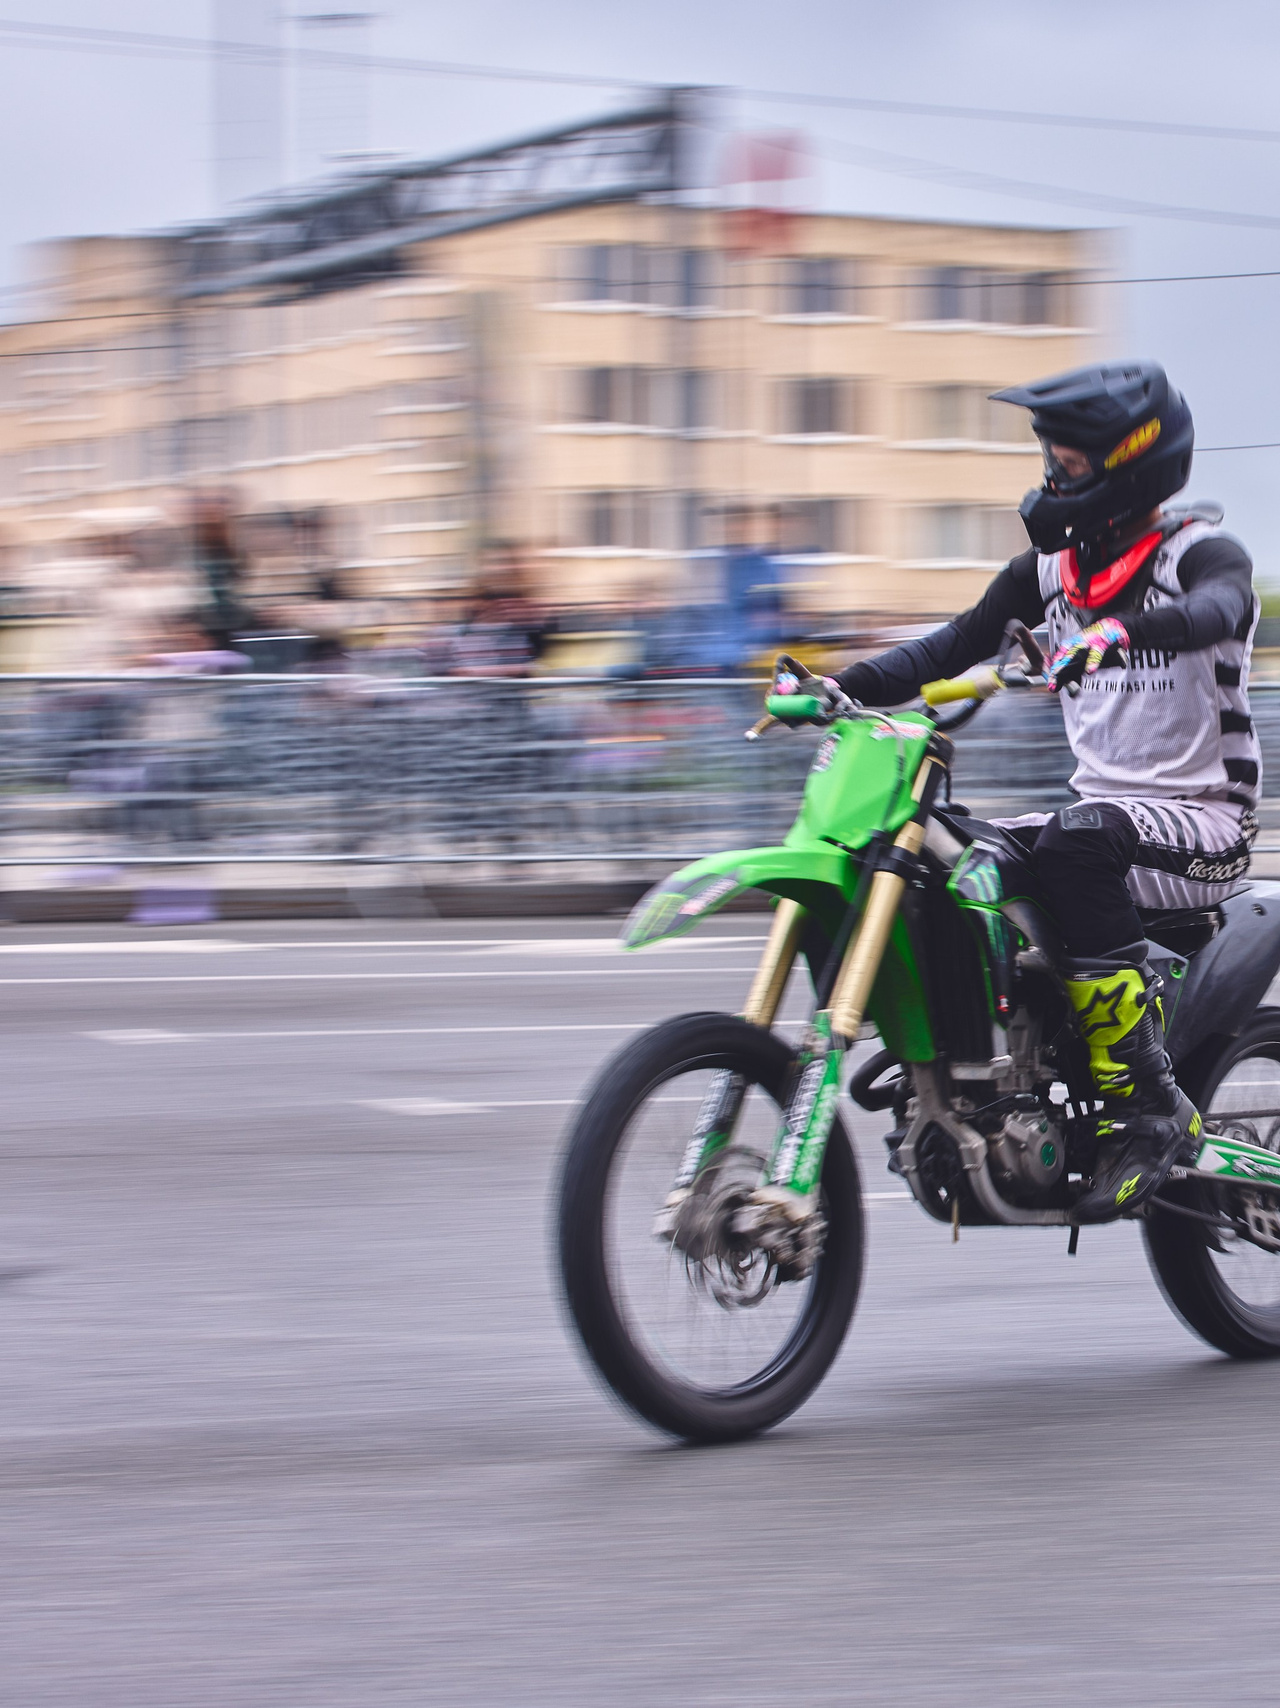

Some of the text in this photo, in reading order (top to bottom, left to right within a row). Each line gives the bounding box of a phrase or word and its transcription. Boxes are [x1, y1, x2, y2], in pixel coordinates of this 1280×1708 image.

[1083, 678, 1100, 690] LIVE
[1120, 679, 1145, 692] FAST
[1151, 678, 1175, 692] LIFE
